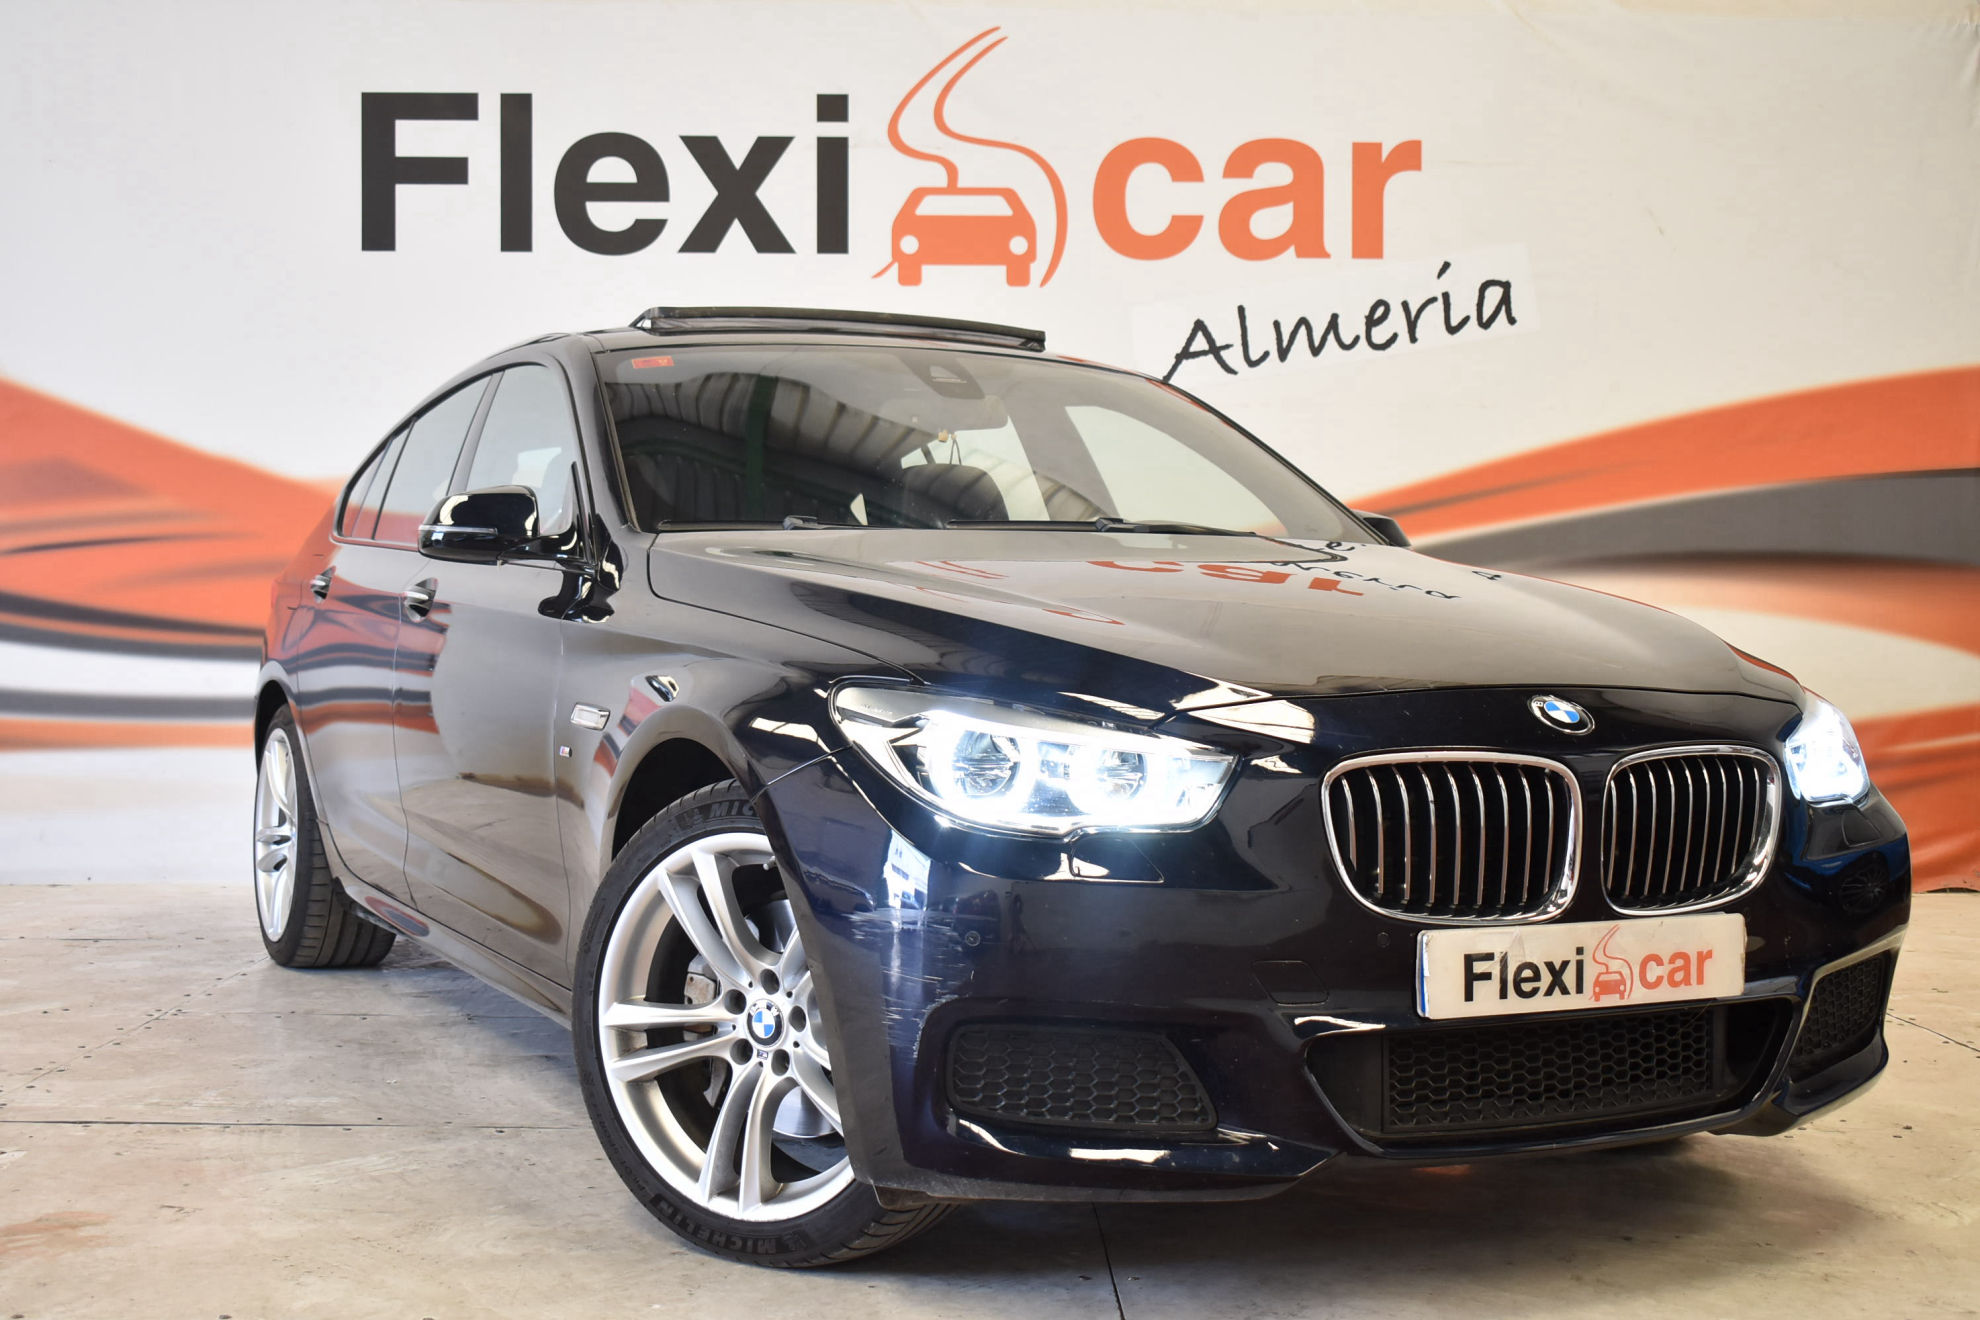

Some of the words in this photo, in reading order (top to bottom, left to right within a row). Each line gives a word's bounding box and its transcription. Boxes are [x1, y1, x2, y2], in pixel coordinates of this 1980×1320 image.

[361, 92, 849, 256] Flexi
[1092, 137, 1423, 261] car
[1164, 261, 1518, 383] Almería
[1463, 946, 1585, 1002] Flexi
[1638, 946, 1713, 991] car
